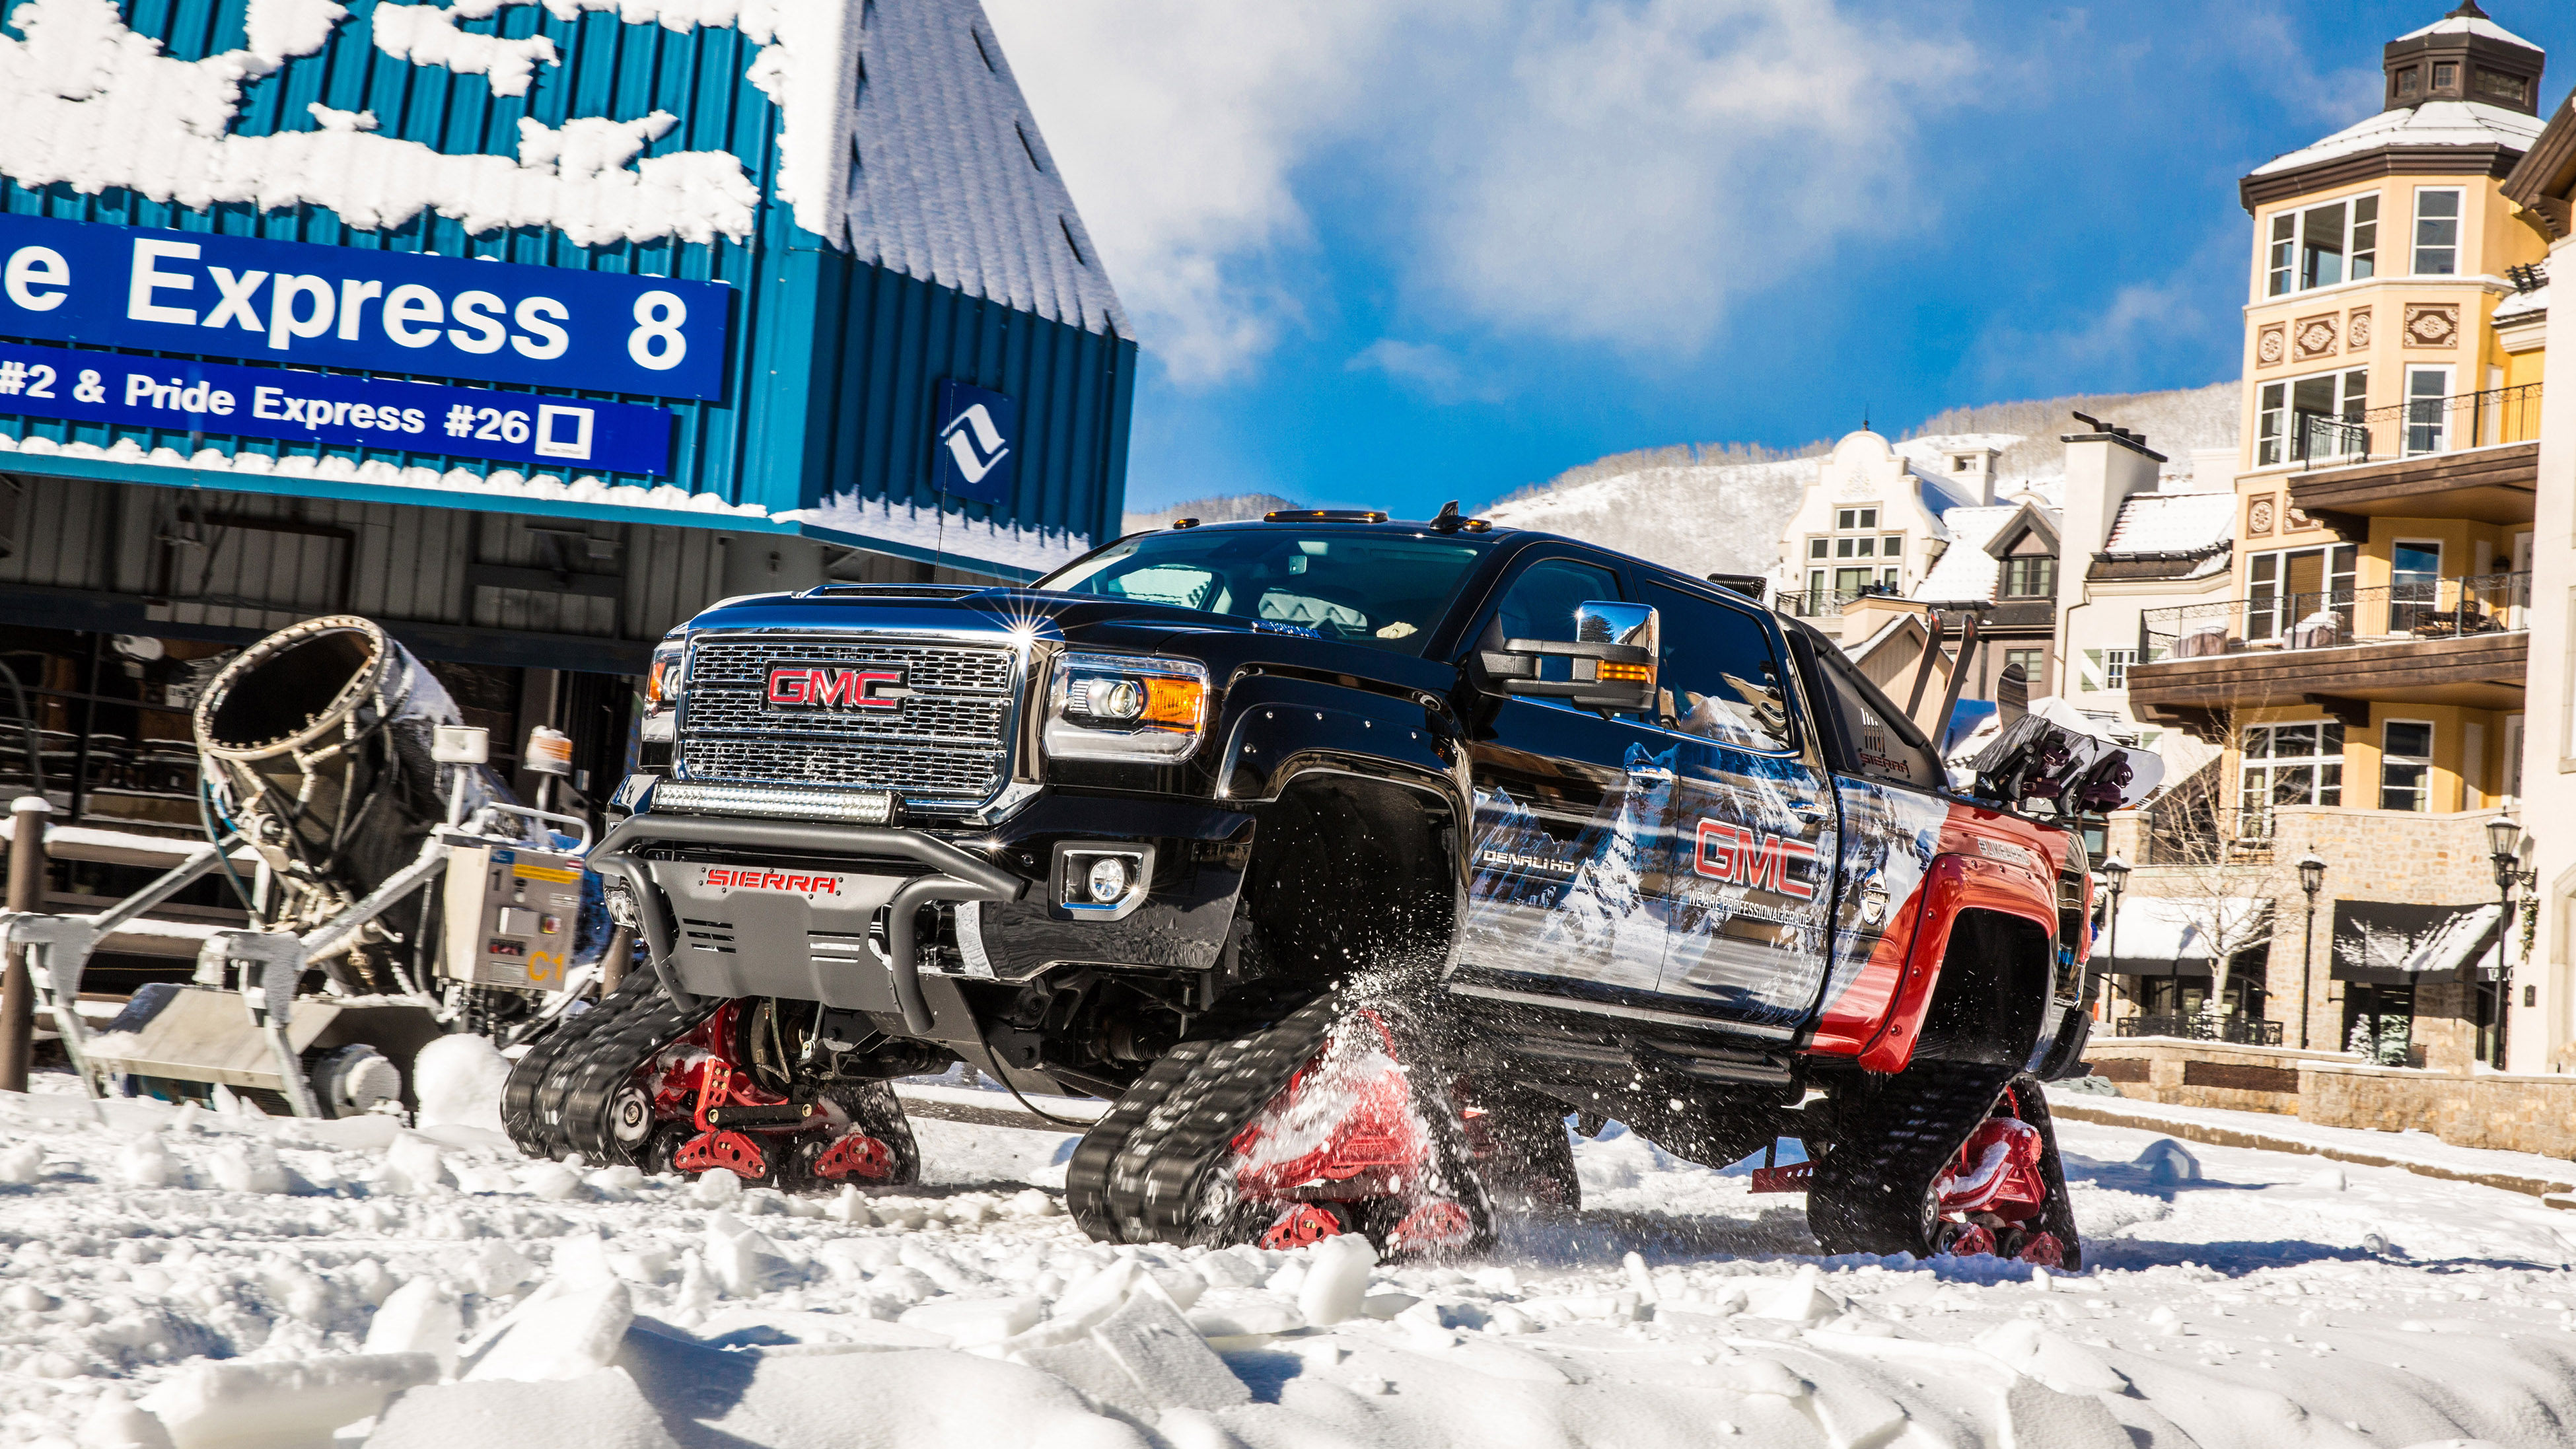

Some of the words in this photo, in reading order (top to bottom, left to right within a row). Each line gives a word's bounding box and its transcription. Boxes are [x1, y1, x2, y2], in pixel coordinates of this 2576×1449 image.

[0, 246, 70, 311] e
[127, 238, 569, 360] Express
[627, 291, 687, 371] 8
[0, 361, 57, 398] #2
[73, 369, 106, 404] &
[125, 374, 236, 415] Pride
[253, 386, 425, 434] Express
[443, 404, 530, 444] #26
[768, 666, 900, 709] GMC
[1860, 752, 1910, 775] SIERRA
[1482, 849, 1548, 870] DENALI
[1550, 858, 1575, 873] HD
[1694, 818, 1817, 901] GMC
[1978, 836, 2030, 866] #LIKEAPRO
[706, 868, 836, 894] SIERRA
[1688, 890, 1703, 907] WE
[1703, 893, 1721, 911] ARE
[1722, 896, 1783, 923] PROFESSIONAL
[1783, 910, 1811, 929] GRADE
[528, 950, 565, 982] C1
